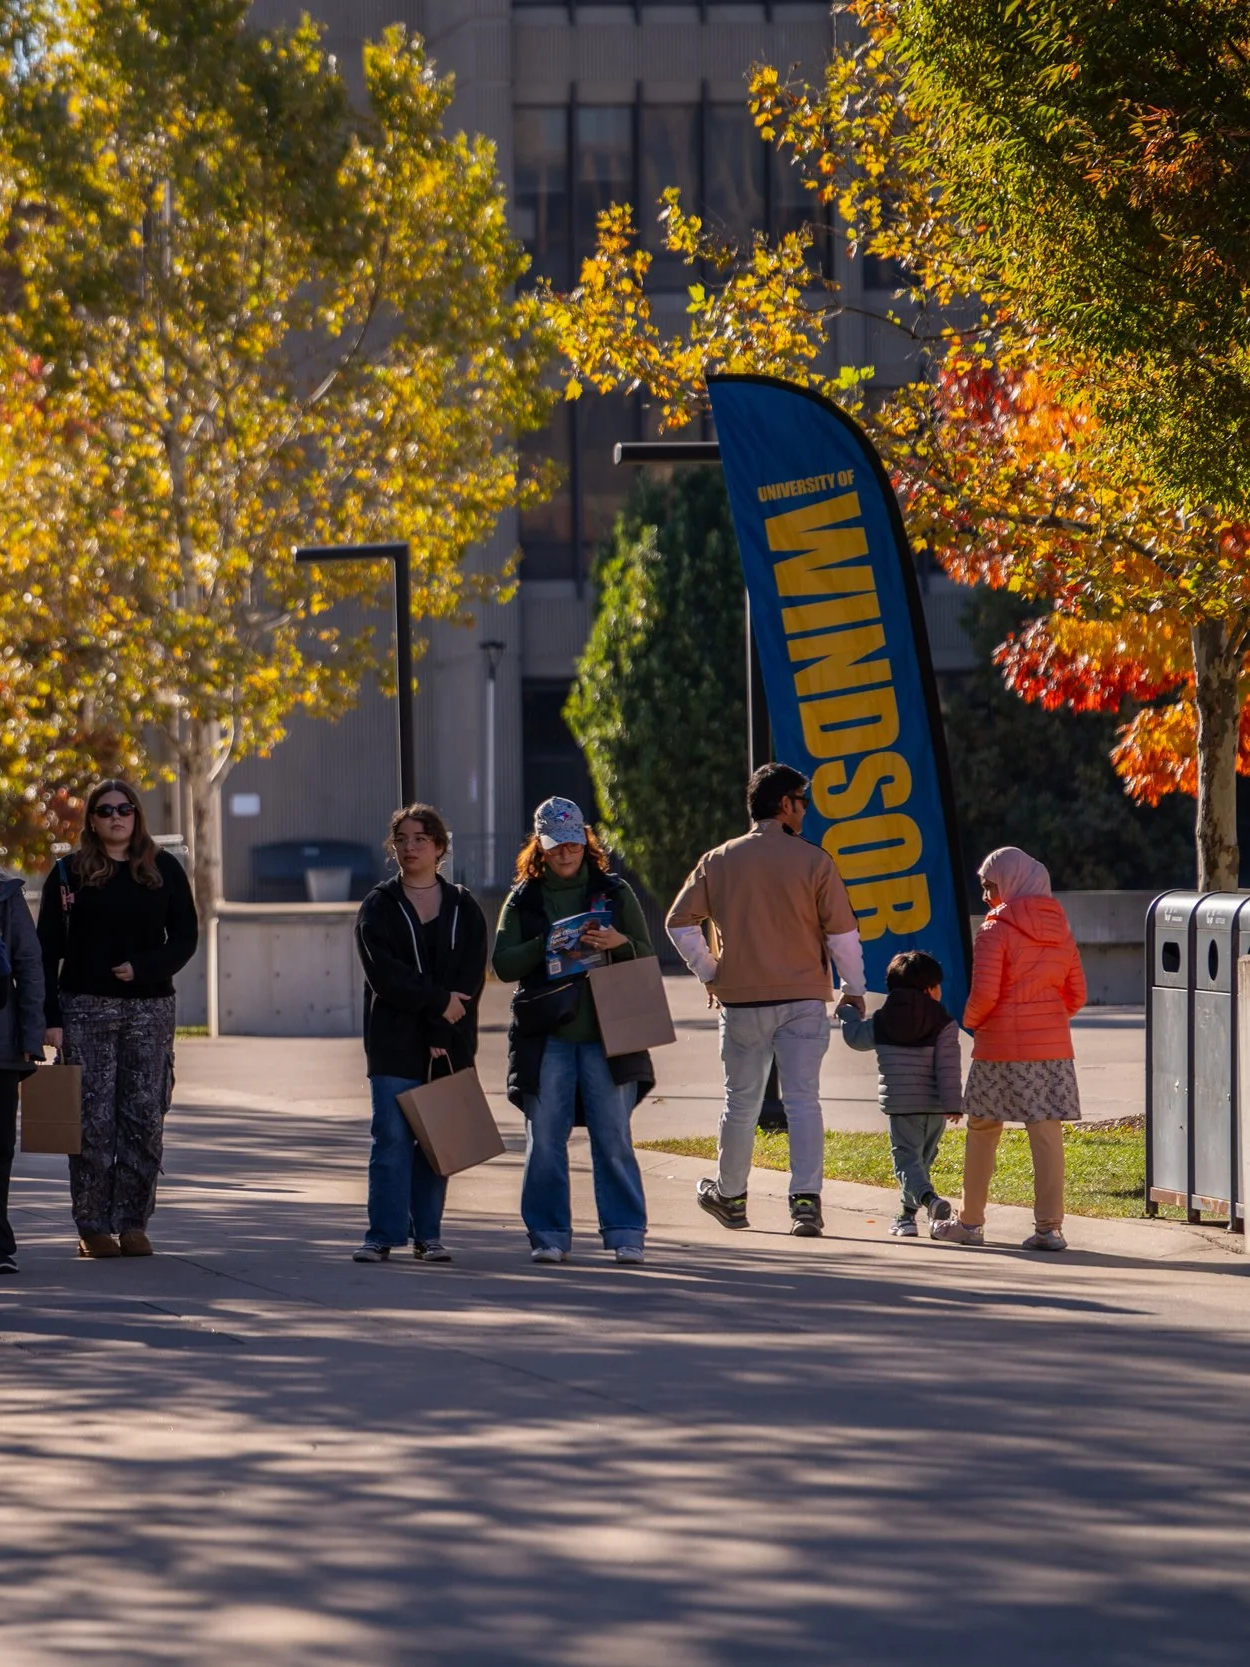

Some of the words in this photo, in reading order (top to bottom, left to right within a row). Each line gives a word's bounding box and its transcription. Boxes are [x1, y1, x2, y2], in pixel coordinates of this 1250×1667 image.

[757, 472, 835, 503] UNIVERSITY
[837, 469, 855, 487] OF
[764, 490, 932, 942] WINDSOR
